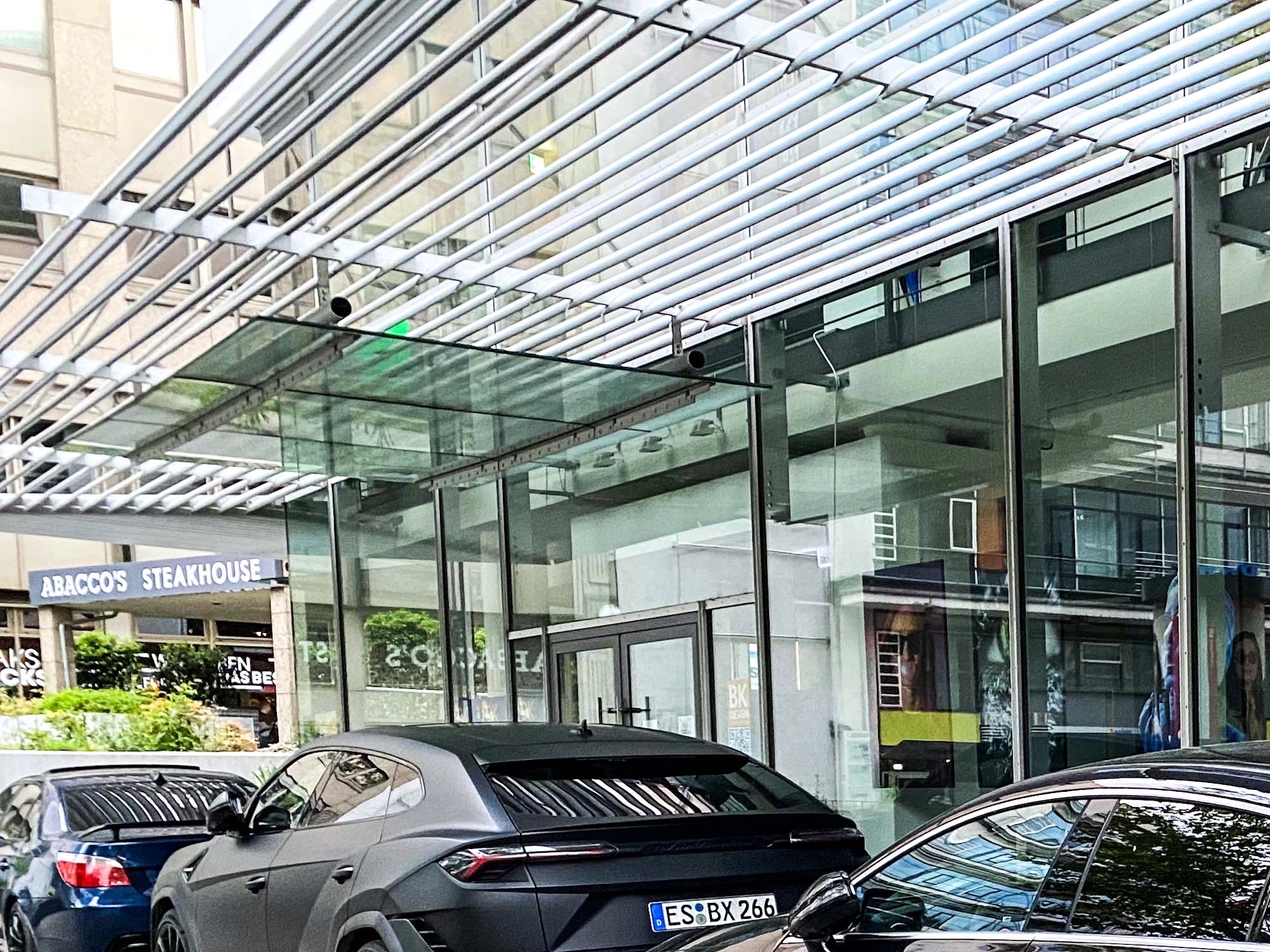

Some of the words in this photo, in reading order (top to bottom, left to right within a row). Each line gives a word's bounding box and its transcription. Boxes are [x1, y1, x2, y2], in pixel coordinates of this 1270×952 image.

[40, 570, 128, 598] ABACCO'S
[141, 558, 262, 590] STEAKHOUSE
[728, 684, 748, 709] BK
[665, 904, 695, 926] ES
[707, 900, 735, 922] BX
[738, 898, 775, 920] 266
